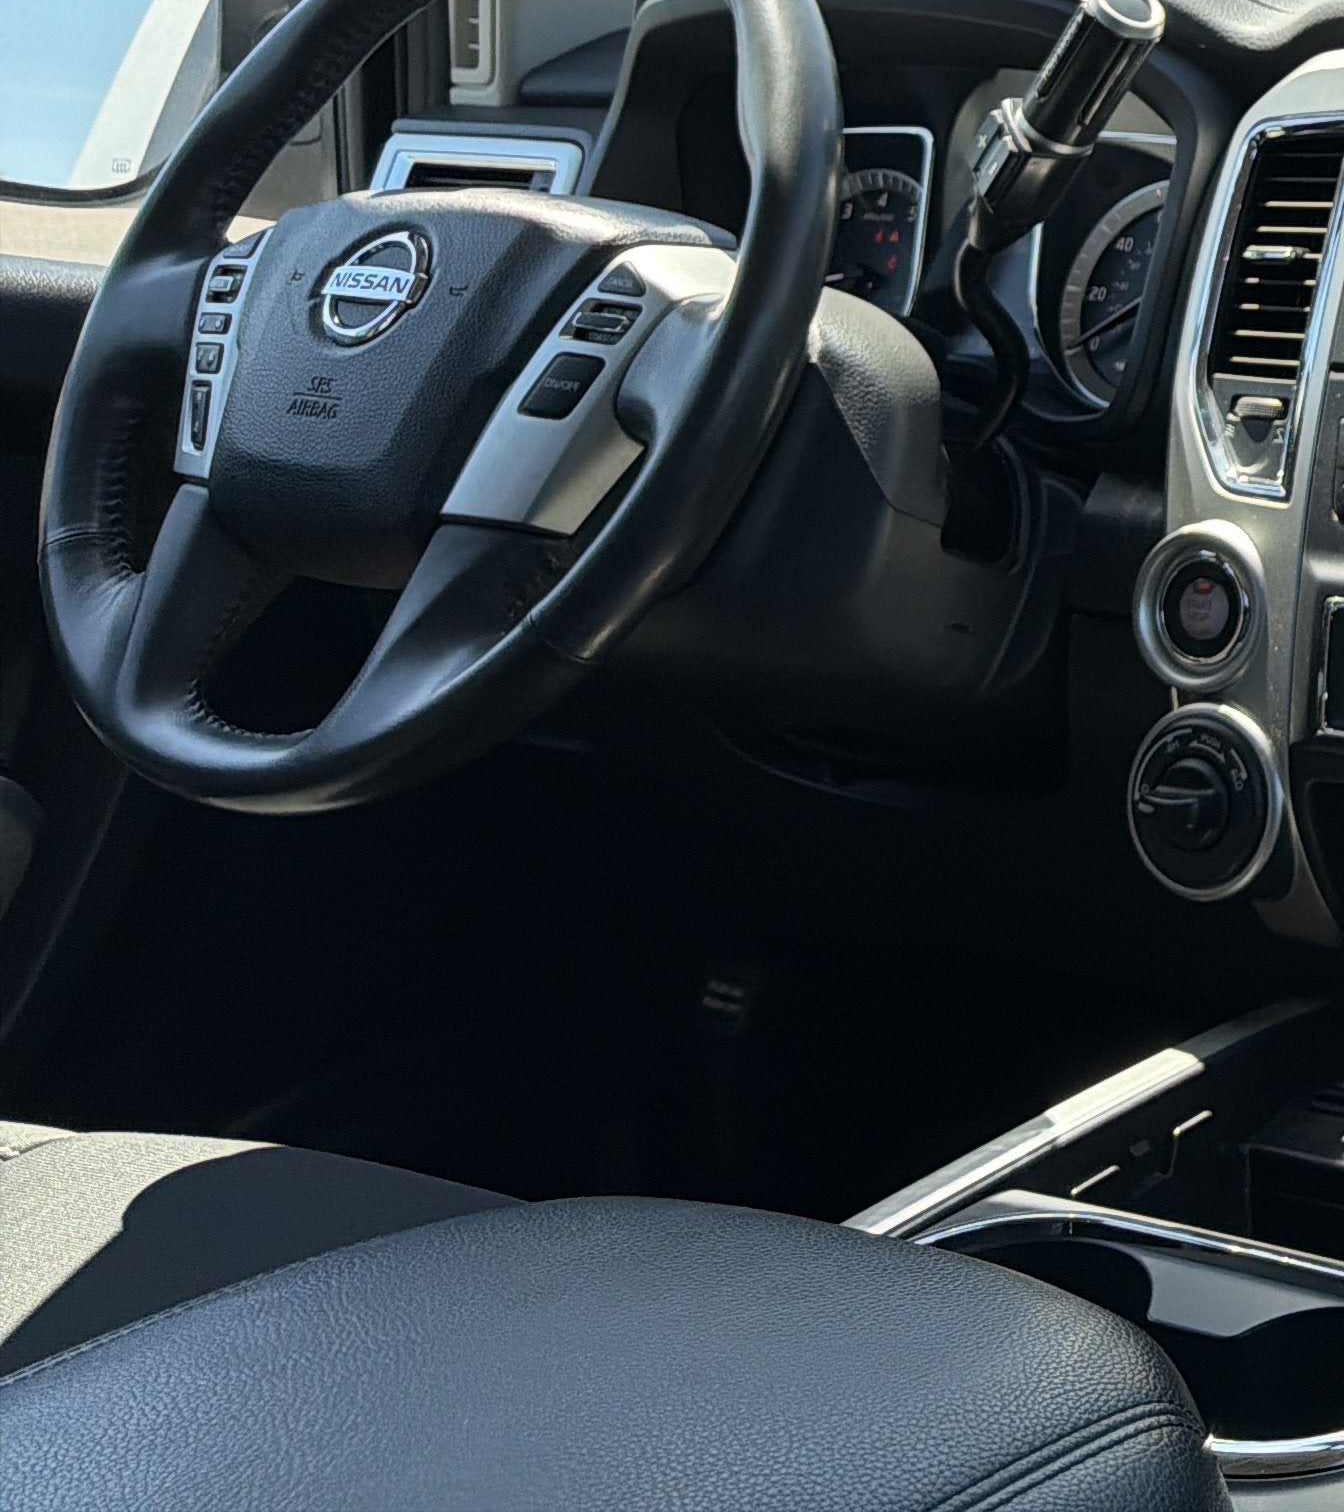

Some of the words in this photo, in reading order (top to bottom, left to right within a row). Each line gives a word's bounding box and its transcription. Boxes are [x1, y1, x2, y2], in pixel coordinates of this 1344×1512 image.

[876, 191, 890, 208] 4
[1115, 237, 1134, 252] 40
[331, 271, 411, 295] NISSAN
[1088, 286, 1107, 302] 20
[309, 376, 335, 394] SRS
[286, 396, 339, 419] AIRBAG
